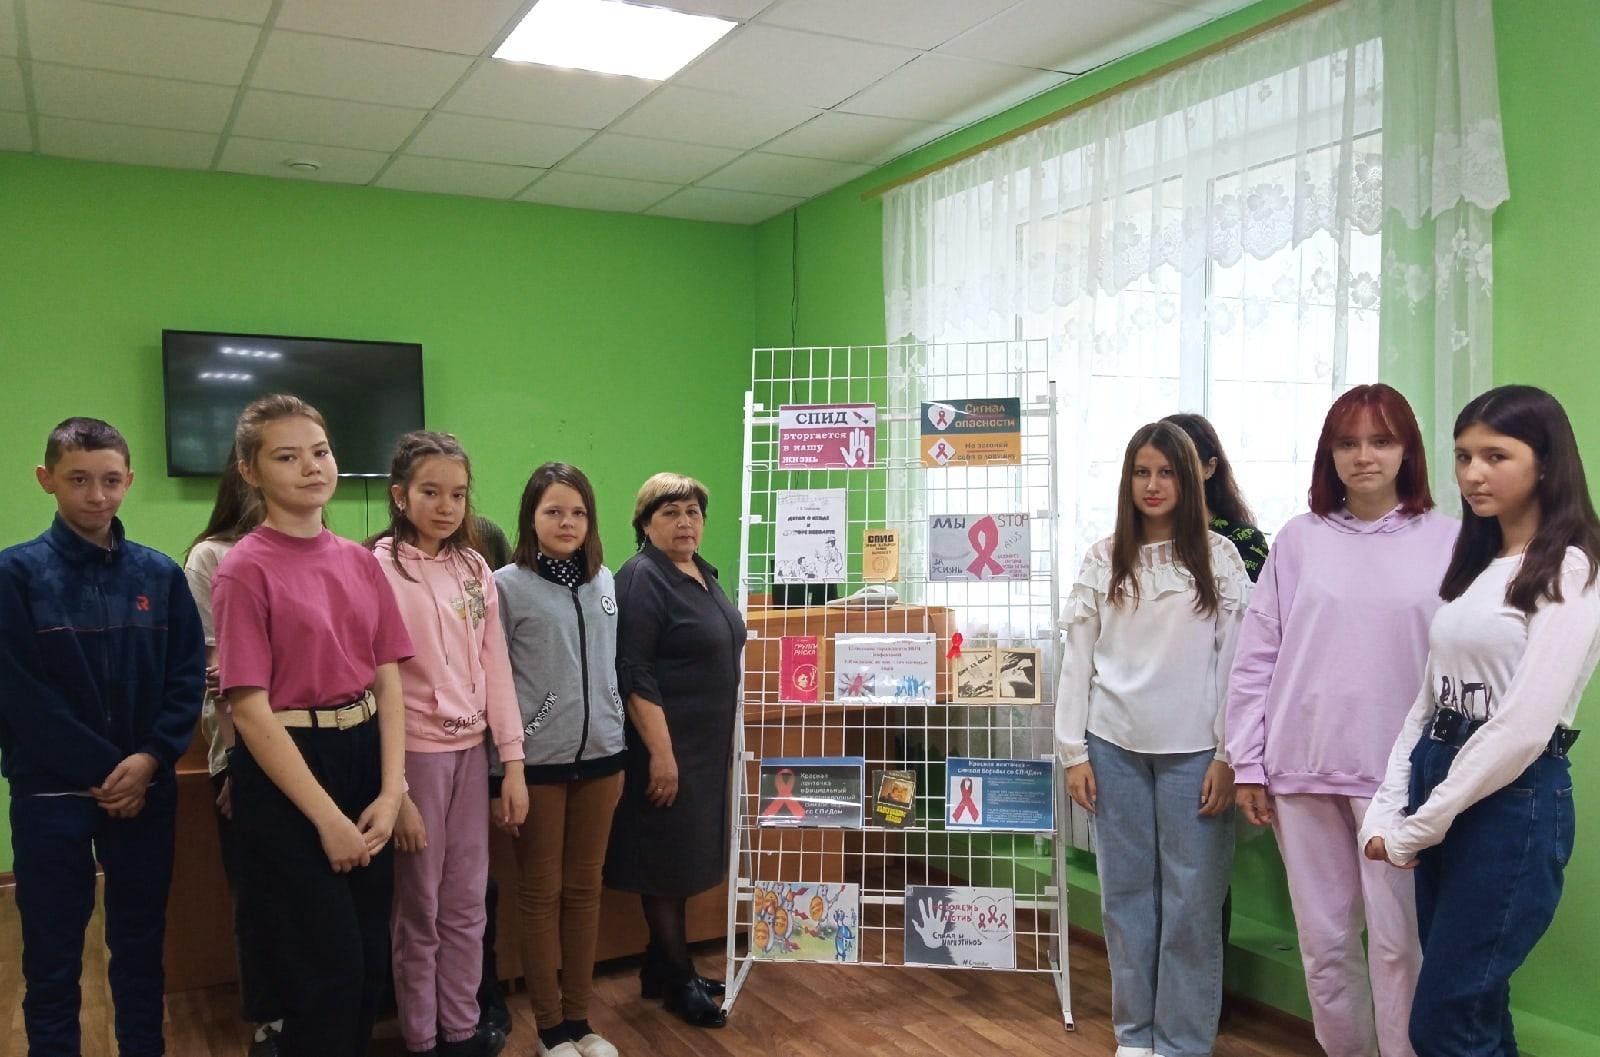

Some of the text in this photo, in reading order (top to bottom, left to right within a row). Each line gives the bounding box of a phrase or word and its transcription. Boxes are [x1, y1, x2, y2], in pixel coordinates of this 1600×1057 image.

[965, 404, 1006, 414] Сигнал
[795, 412, 848, 425] СПИД
[955, 419, 1015, 428] опасности
[783, 433, 847, 441] вторгается
[794, 445, 823, 453] нашу
[933, 517, 966, 528] МЫ
[998, 514, 1029, 527] STOP
[868, 535, 894, 543] СПИД
